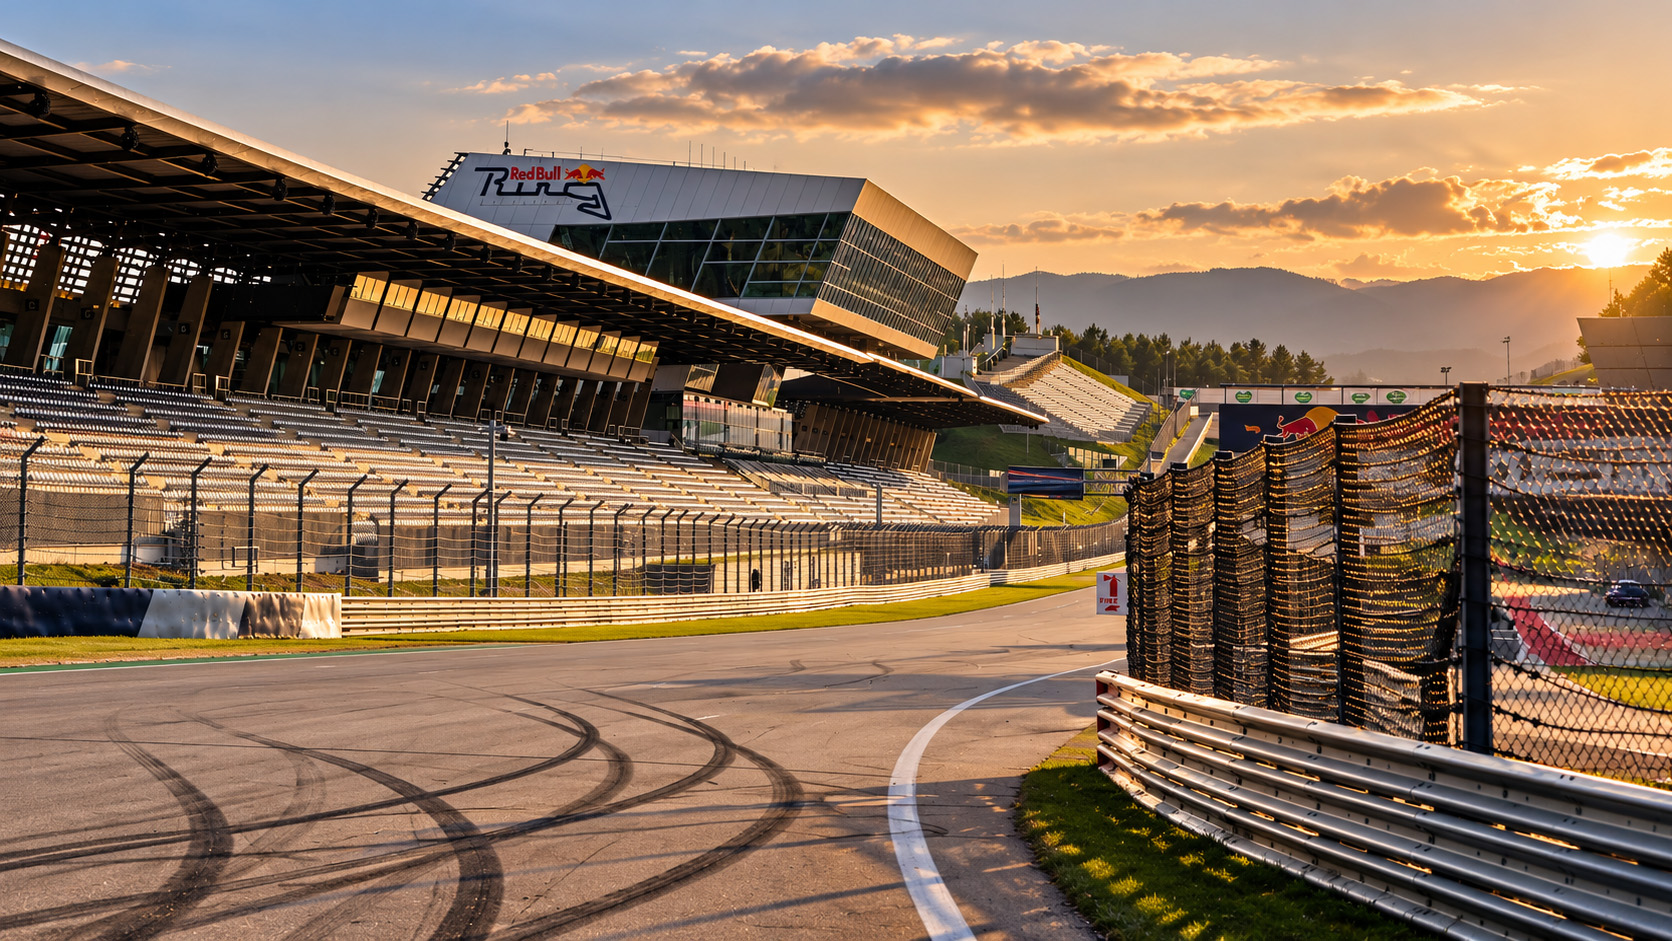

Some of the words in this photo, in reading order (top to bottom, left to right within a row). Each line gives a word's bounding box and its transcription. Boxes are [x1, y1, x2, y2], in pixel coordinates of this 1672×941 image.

[510, 166, 535, 181] Red
[536, 166, 561, 180] Bull
[474, 167, 612, 220] Ring
